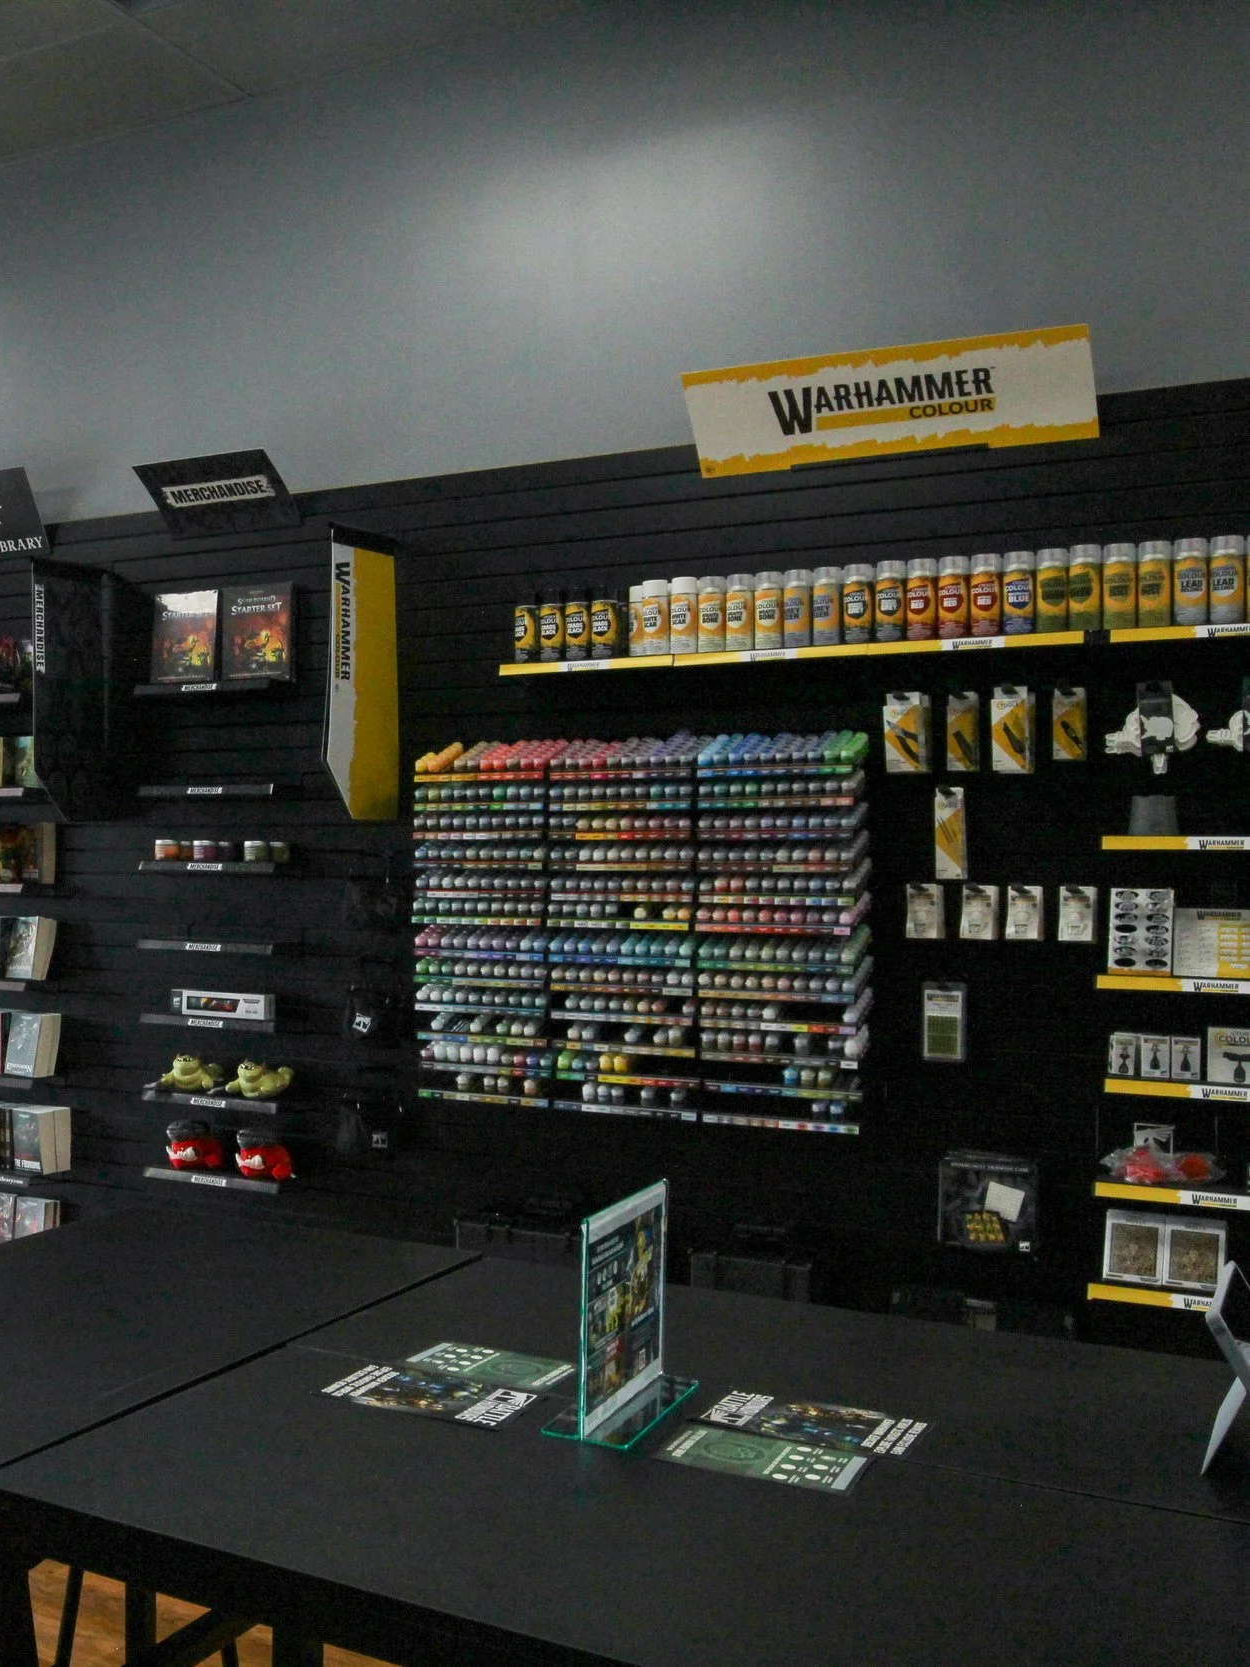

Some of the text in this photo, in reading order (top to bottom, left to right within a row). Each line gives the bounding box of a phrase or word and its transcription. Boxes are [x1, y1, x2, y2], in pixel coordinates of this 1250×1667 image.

[768, 367, 994, 436] WARHAMMER
[909, 398, 994, 420] COLOUR
[170, 479, 267, 504] MERCHANDISE
[1213, 577, 1234, 586] LEAD
[231, 602, 282, 616] STARTER SET
[335, 562, 350, 680] WARHAMMER
[35, 589, 44, 669] MERCHANDISE
[952, 640, 993, 649] WARHAMMER
[1199, 839, 1245, 850] WARHAMMER
[1193, 982, 1239, 992] WARHAMMER
[1202, 1088, 1247, 1099] WARHAMMER
[1192, 1194, 1237, 1205] WARHAMMER
[1183, 1298, 1212, 1309] WARHA
